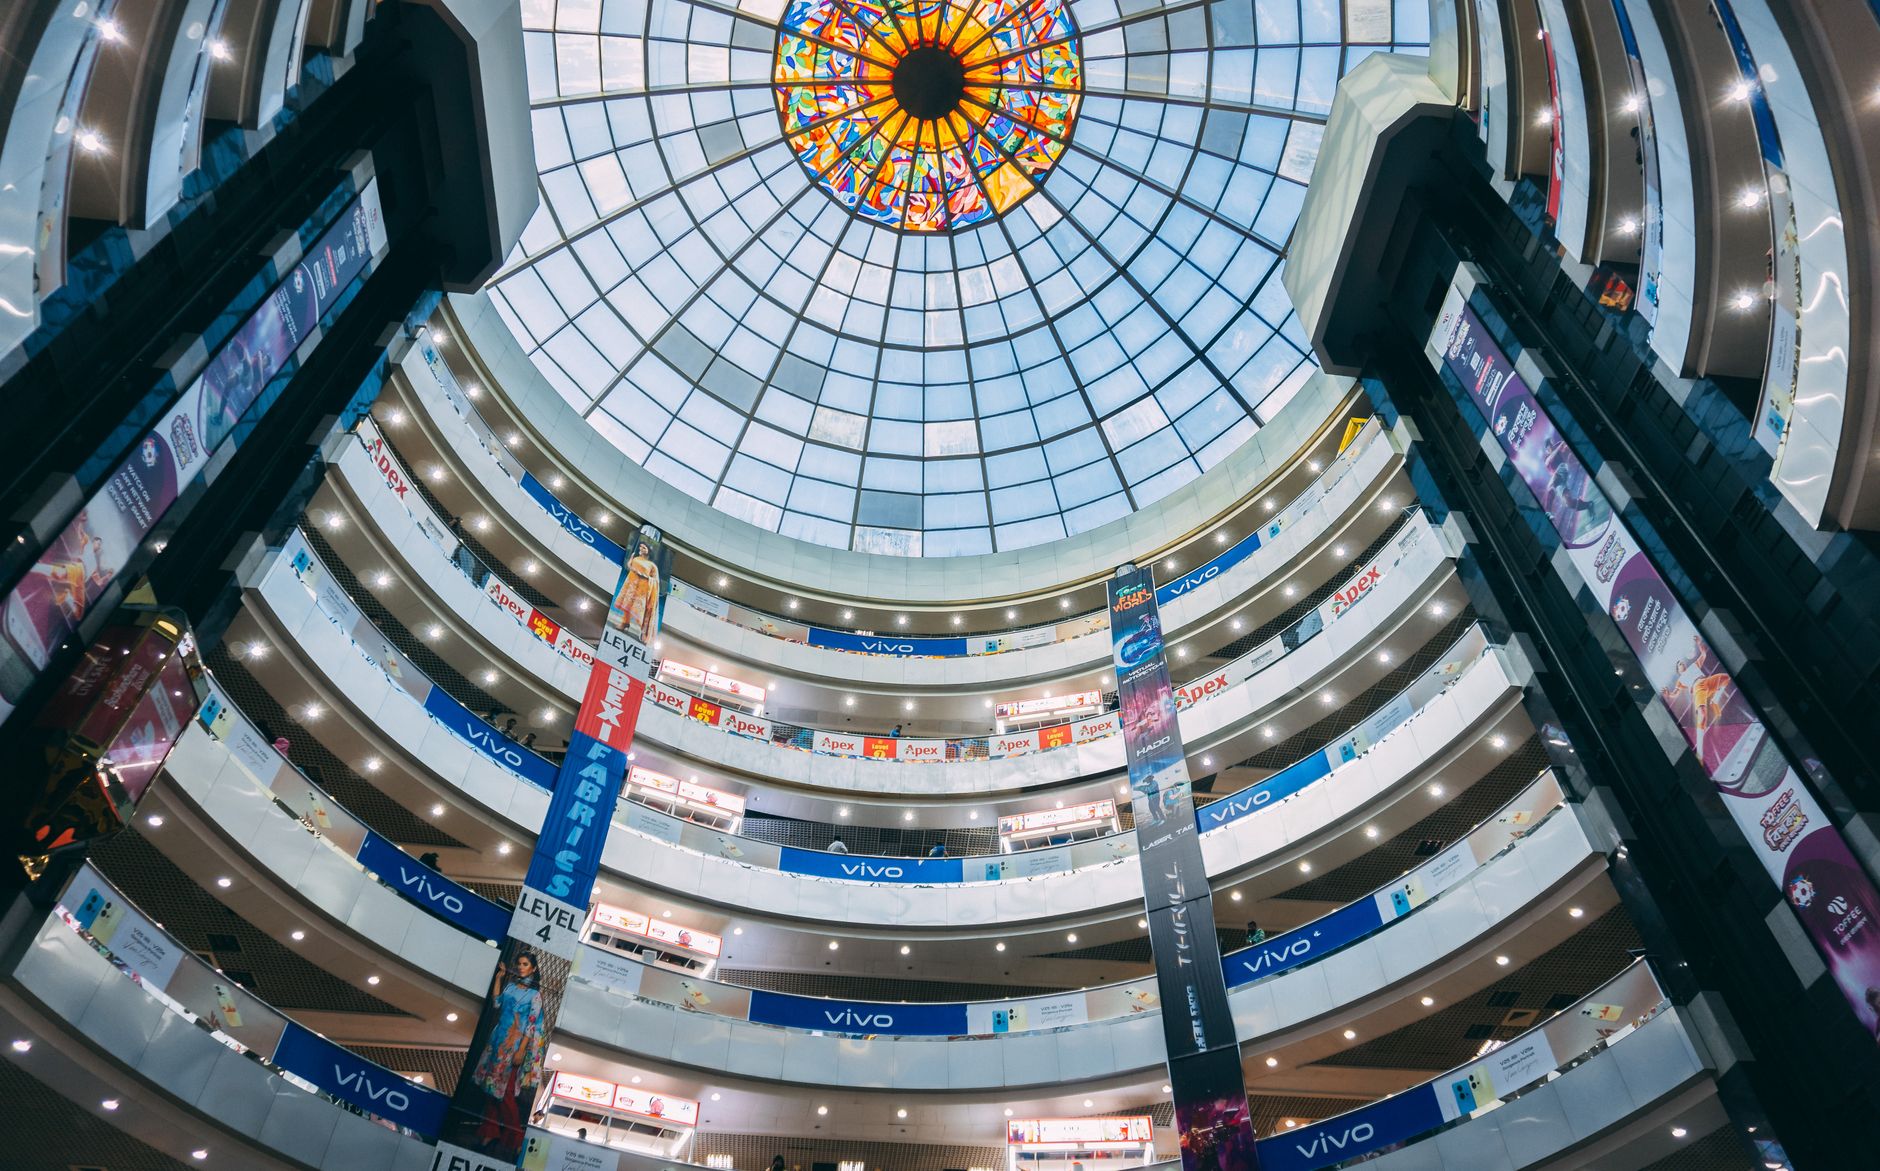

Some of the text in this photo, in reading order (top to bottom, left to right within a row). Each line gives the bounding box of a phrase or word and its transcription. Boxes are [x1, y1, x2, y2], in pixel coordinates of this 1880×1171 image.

[120, 471, 152, 522] ANY NETWORK
[127, 463, 150, 502] WATCH ON
[114, 478, 148, 529] ON ANY SMART
[550, 502, 596, 544] vivo
[1170, 566, 1220, 596] vivo
[1331, 564, 1382, 614] Apex
[489, 583, 526, 619] Apex
[1112, 593, 1152, 613] WORLD
[533, 617, 553, 635] Level
[603, 630, 651, 665] LEVEL
[616, 655, 629, 668] 4
[861, 641, 914, 654] vivo
[645, 683, 685, 710] Apex
[1174, 672, 1229, 707] Apex
[596, 668, 632, 742] BEXI
[694, 703, 715, 717] Level
[725, 714, 766, 736] Apex
[1080, 720, 1113, 737] Apex
[465, 722, 523, 767] vivo
[821, 737, 854, 751] Apex
[905, 744, 938, 757] Apex
[997, 738, 1030, 752] Apex
[1136, 735, 1171, 757] HADO
[545, 742, 612, 899] FABRICS
[1210, 789, 1271, 823] vivo
[1142, 822, 1195, 851] LASER TAG
[840, 862, 903, 878] vivo
[399, 866, 464, 914] vivo
[518, 892, 580, 934] LEVEL
[1833, 905, 1863, 935] TOFFEE
[535, 924, 552, 943] 4
[1243, 938, 1311, 973] vivo
[824, 1008, 894, 1028] vivo
[334, 1064, 410, 1112] vivo
[1296, 1121, 1375, 1160] vivo
